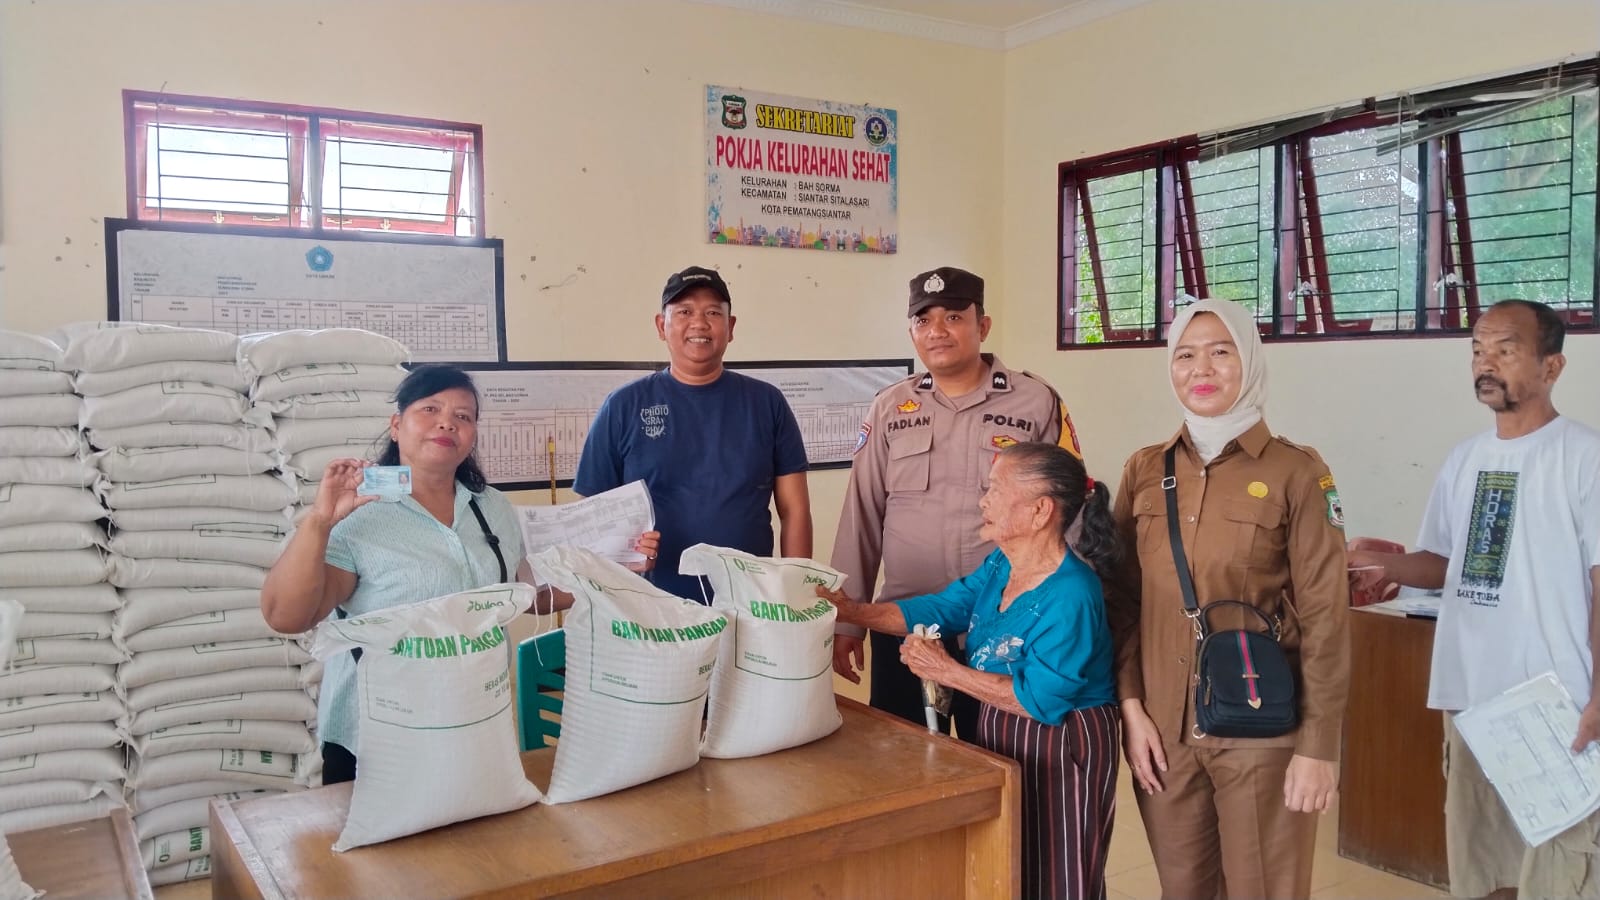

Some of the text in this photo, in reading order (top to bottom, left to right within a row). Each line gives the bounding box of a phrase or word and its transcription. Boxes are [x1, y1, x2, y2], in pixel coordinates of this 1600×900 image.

[755, 104, 855, 138] SEKRETARIAT
[716, 135, 890, 183] POKJA KELURAHAN SEHAT
[741, 175, 787, 188] KELURAHAN
[798, 181, 814, 191] BAH
[815, 182, 840, 193] SORMA
[741, 188, 787, 200] KECAMATAN
[798, 192, 828, 204] SIANTAR
[830, 195, 870, 207] SITALASARI
[761, 204, 851, 220] KOTA PEMATANGSIANTAR
[645, 406, 669, 416] PHOTO
[887, 416, 931, 433] FADLAN
[982, 413, 1032, 433] POLRI
[675, 616, 728, 642] PANGAN
